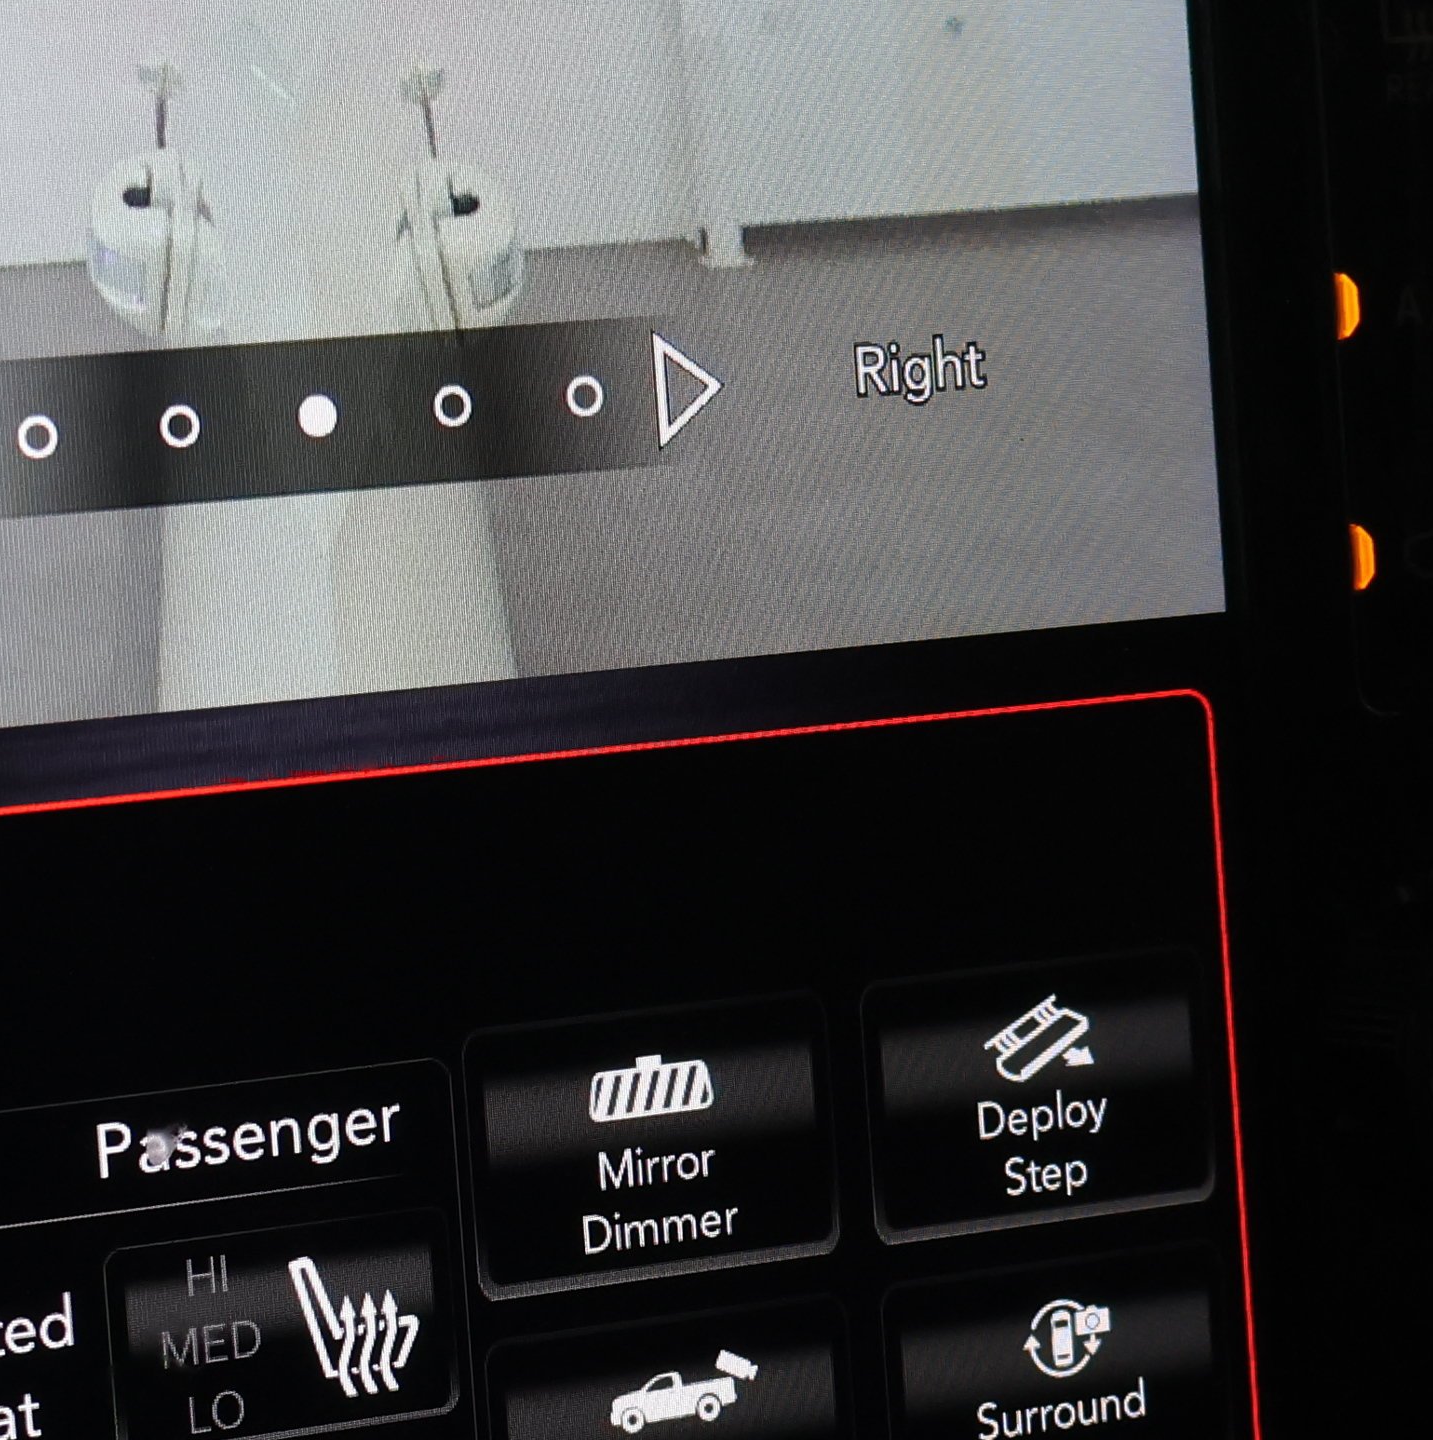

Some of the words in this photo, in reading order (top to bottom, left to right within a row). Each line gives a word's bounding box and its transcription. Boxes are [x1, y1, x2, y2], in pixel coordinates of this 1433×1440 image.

[854, 334, 988, 406] Right
[978, 1090, 1107, 1140] Deploy
[97, 1101, 400, 1178] Passenger
[598, 1147, 714, 1190] Mirror
[1005, 1156, 1087, 1196] Step
[583, 1208, 738, 1254] Dimmer
[186, 1254, 229, 1299] HI
[161, 1320, 262, 1373] MED
[189, 1389, 245, 1434] LO
[977, 1377, 1145, 1440] Surround
